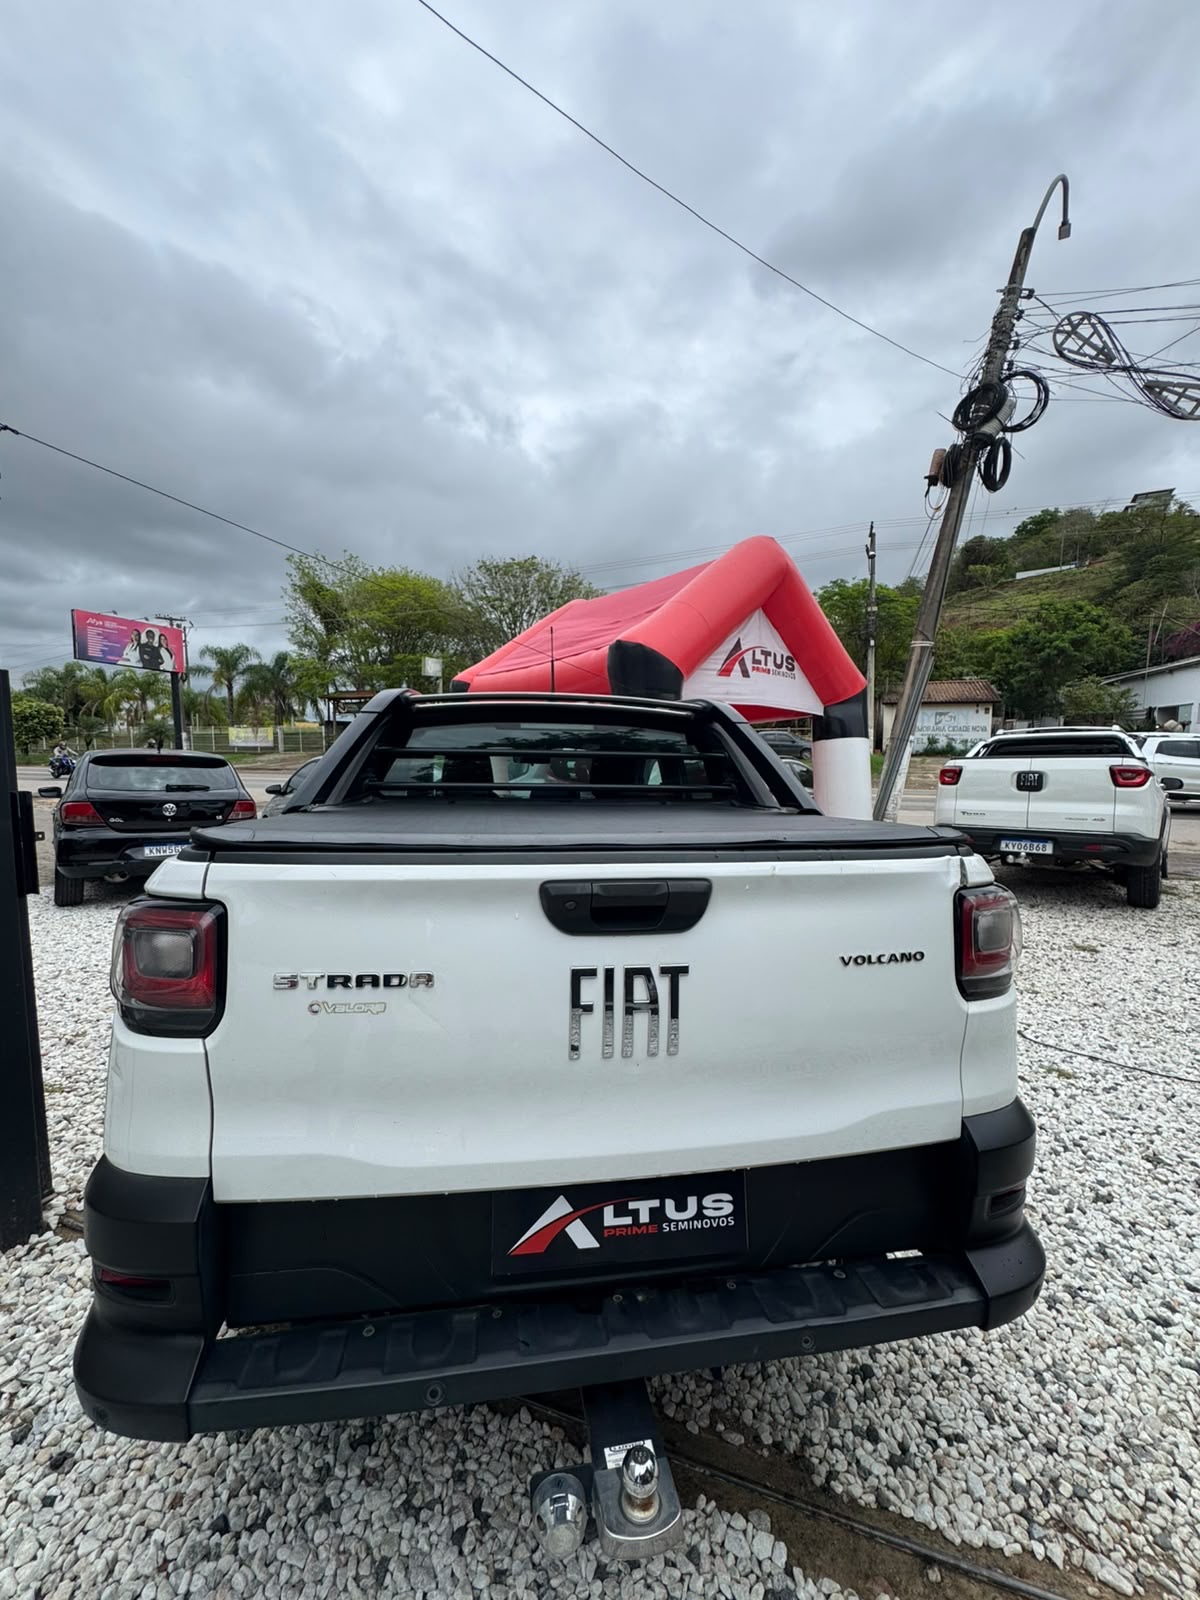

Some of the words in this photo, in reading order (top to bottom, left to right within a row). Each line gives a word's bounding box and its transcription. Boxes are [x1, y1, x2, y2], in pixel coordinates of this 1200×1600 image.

[717, 637, 796, 678] ALTUS
[751, 665, 771, 675] PRIME
[971, 724, 988, 732] NOVA
[1020, 772, 1040, 786] FIAT
[839, 950, 925, 967] VOLCANO
[273, 970, 435, 990] STRADA
[568, 962, 690, 1061] FIAT
[506, 1192, 735, 1256] ALTUS
[603, 1223, 658, 1238] PRIME
[662, 1216, 735, 1233] SEMINOVOS
